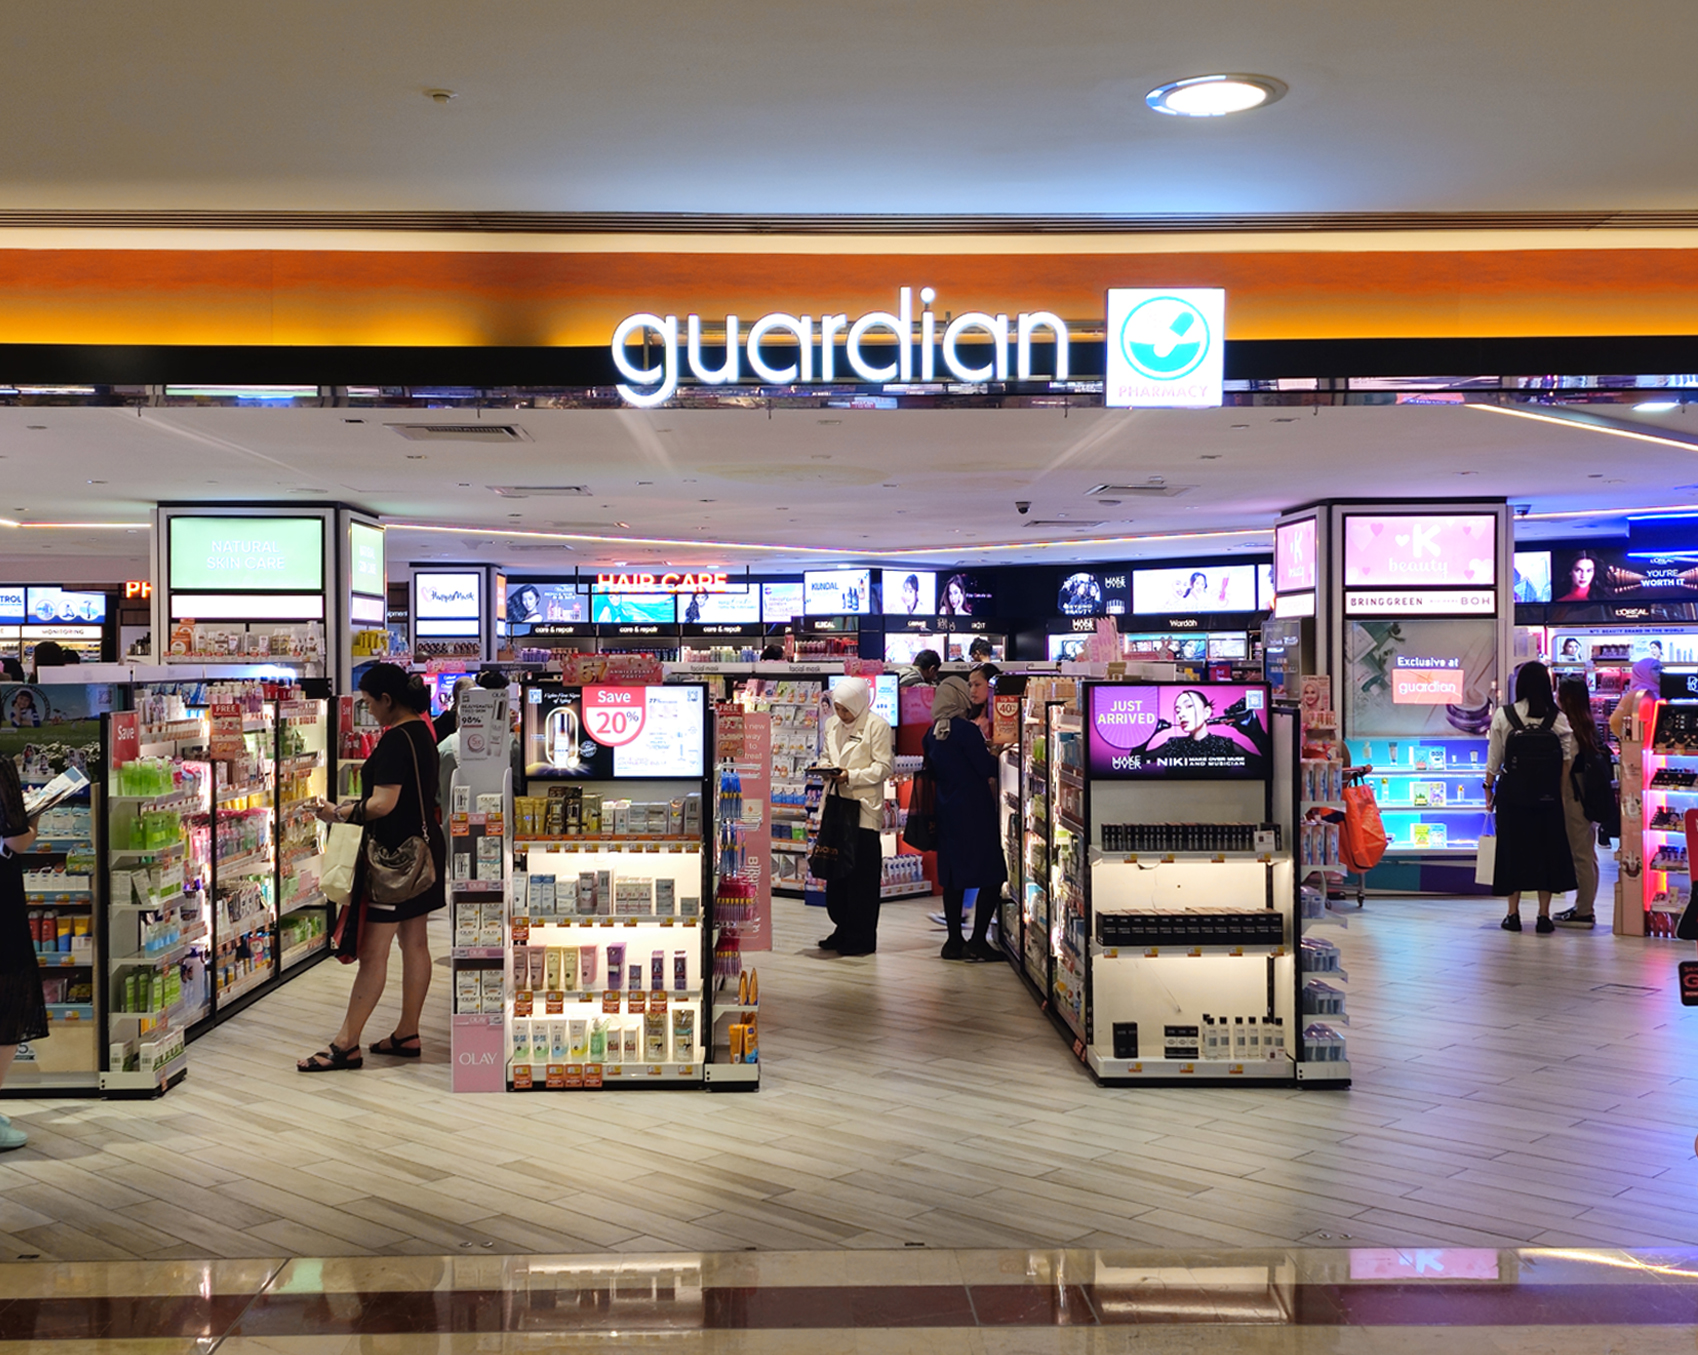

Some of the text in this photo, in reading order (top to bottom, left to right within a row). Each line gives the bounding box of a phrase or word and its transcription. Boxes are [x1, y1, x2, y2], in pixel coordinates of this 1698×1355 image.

[611, 286, 1069, 407] guardian
[1118, 384, 1209, 398] PHARMACY
[211, 540, 280, 553] NATURAL
[1412, 523, 1441, 558] K
[206, 556, 285, 570] SKIN CARE
[1388, 557, 1448, 578] beauty
[1646, 569, 1679, 577] YOU'RE
[598, 572, 728, 592] HAIR CARE
[811, 582, 840, 591] KUNDAL
[1640, 578, 1685, 587] WORTH IT
[1169, 619, 1198, 627] Wardah
[1397, 656, 1459, 667] Exclusive at
[1398, 680, 1456, 694] guardian
[597, 690, 631, 703] Save
[215, 704, 236, 712] FREE
[1110, 700, 1143, 711] JUST
[596, 711, 639, 734] 20%
[1097, 713, 1155, 724] ARRIVED
[117, 725, 135, 741] Save
[1112, 755, 1141, 763] MAKE
[1112, 761, 1142, 770] OVER
[1157, 757, 1188, 767] NIKI
[459, 1052, 498, 1065] OLAY
